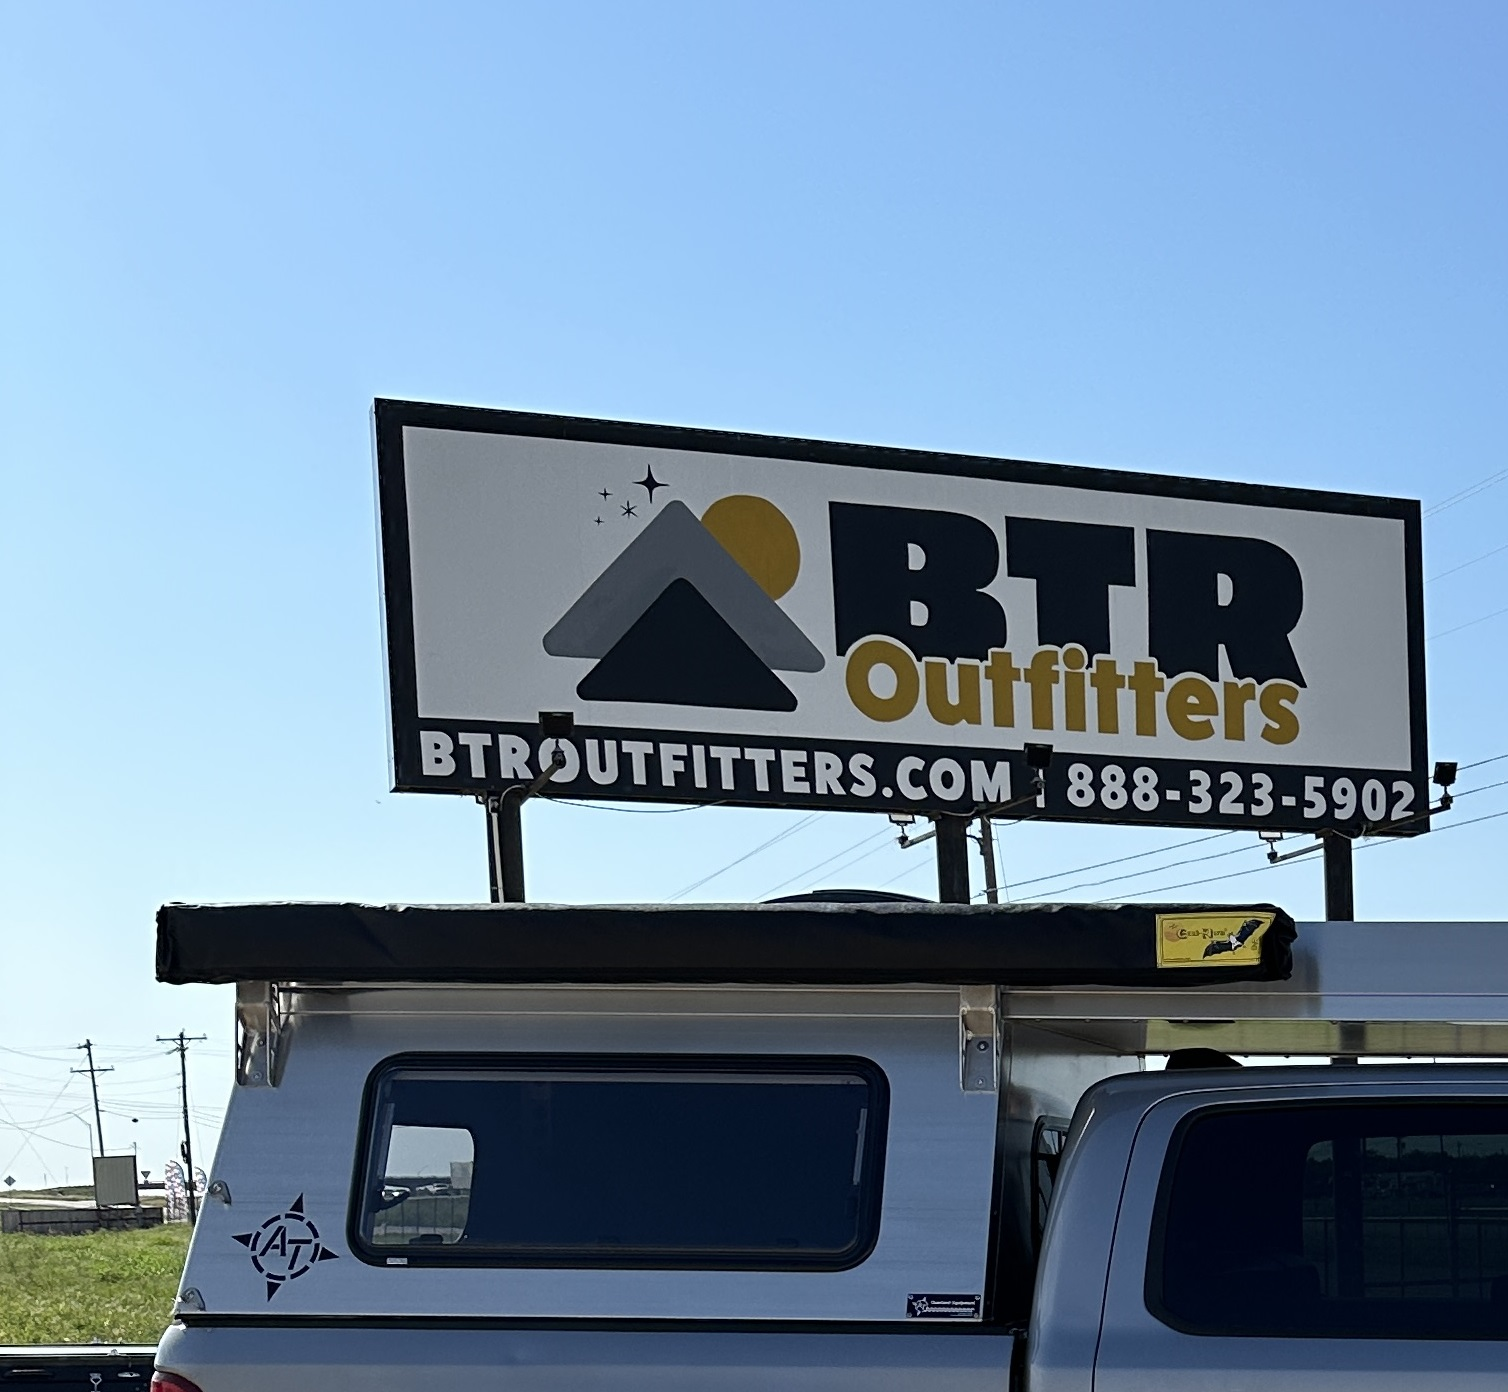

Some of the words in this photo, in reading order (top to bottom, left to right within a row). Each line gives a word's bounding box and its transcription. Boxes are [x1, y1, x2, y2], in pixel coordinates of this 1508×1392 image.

[829, 501, 1307, 688] BTR
[845, 638, 1300, 745] Outfitters
[419, 731, 1012, 803] BTROUTFITTERS.COM
[1067, 762, 1415, 822] 888-323-5902
[259, 1226, 313, 1270] AT
